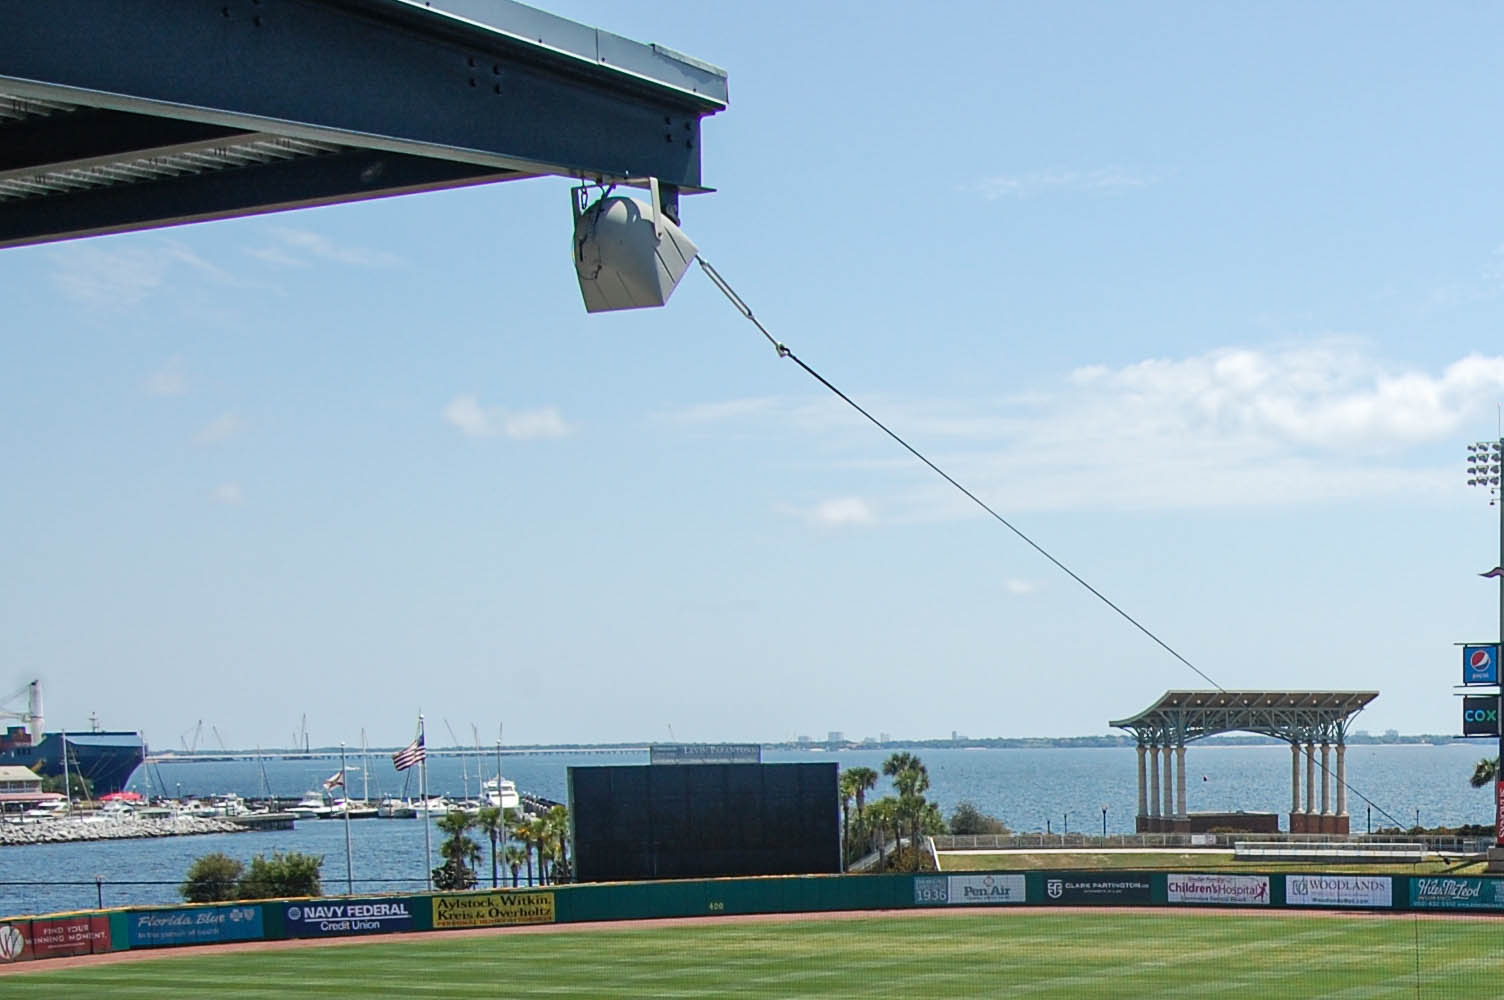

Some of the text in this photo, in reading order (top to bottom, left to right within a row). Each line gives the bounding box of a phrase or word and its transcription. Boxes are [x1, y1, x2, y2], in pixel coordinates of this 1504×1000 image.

[1465, 710, 1497, 722] COX
[1168, 881, 1258, 897] Children's Hospital
[1310, 878, 1385, 891] WOODLANDS
[918, 888, 946, 901] 1936
[964, 886, 990, 898] Pen
[991, 886, 1012, 897] Air
[304, 903, 409, 918] NAVY FEDERAL
[438, 909, 474, 921] Kreis
[487, 906, 552, 919] Overholtz
[137, 911, 225, 928] Florida Blue
[320, 918, 380, 931] Credit Union
[43, 923, 89, 936] FIND YOUR
[25, 934, 65, 945] WINNING
